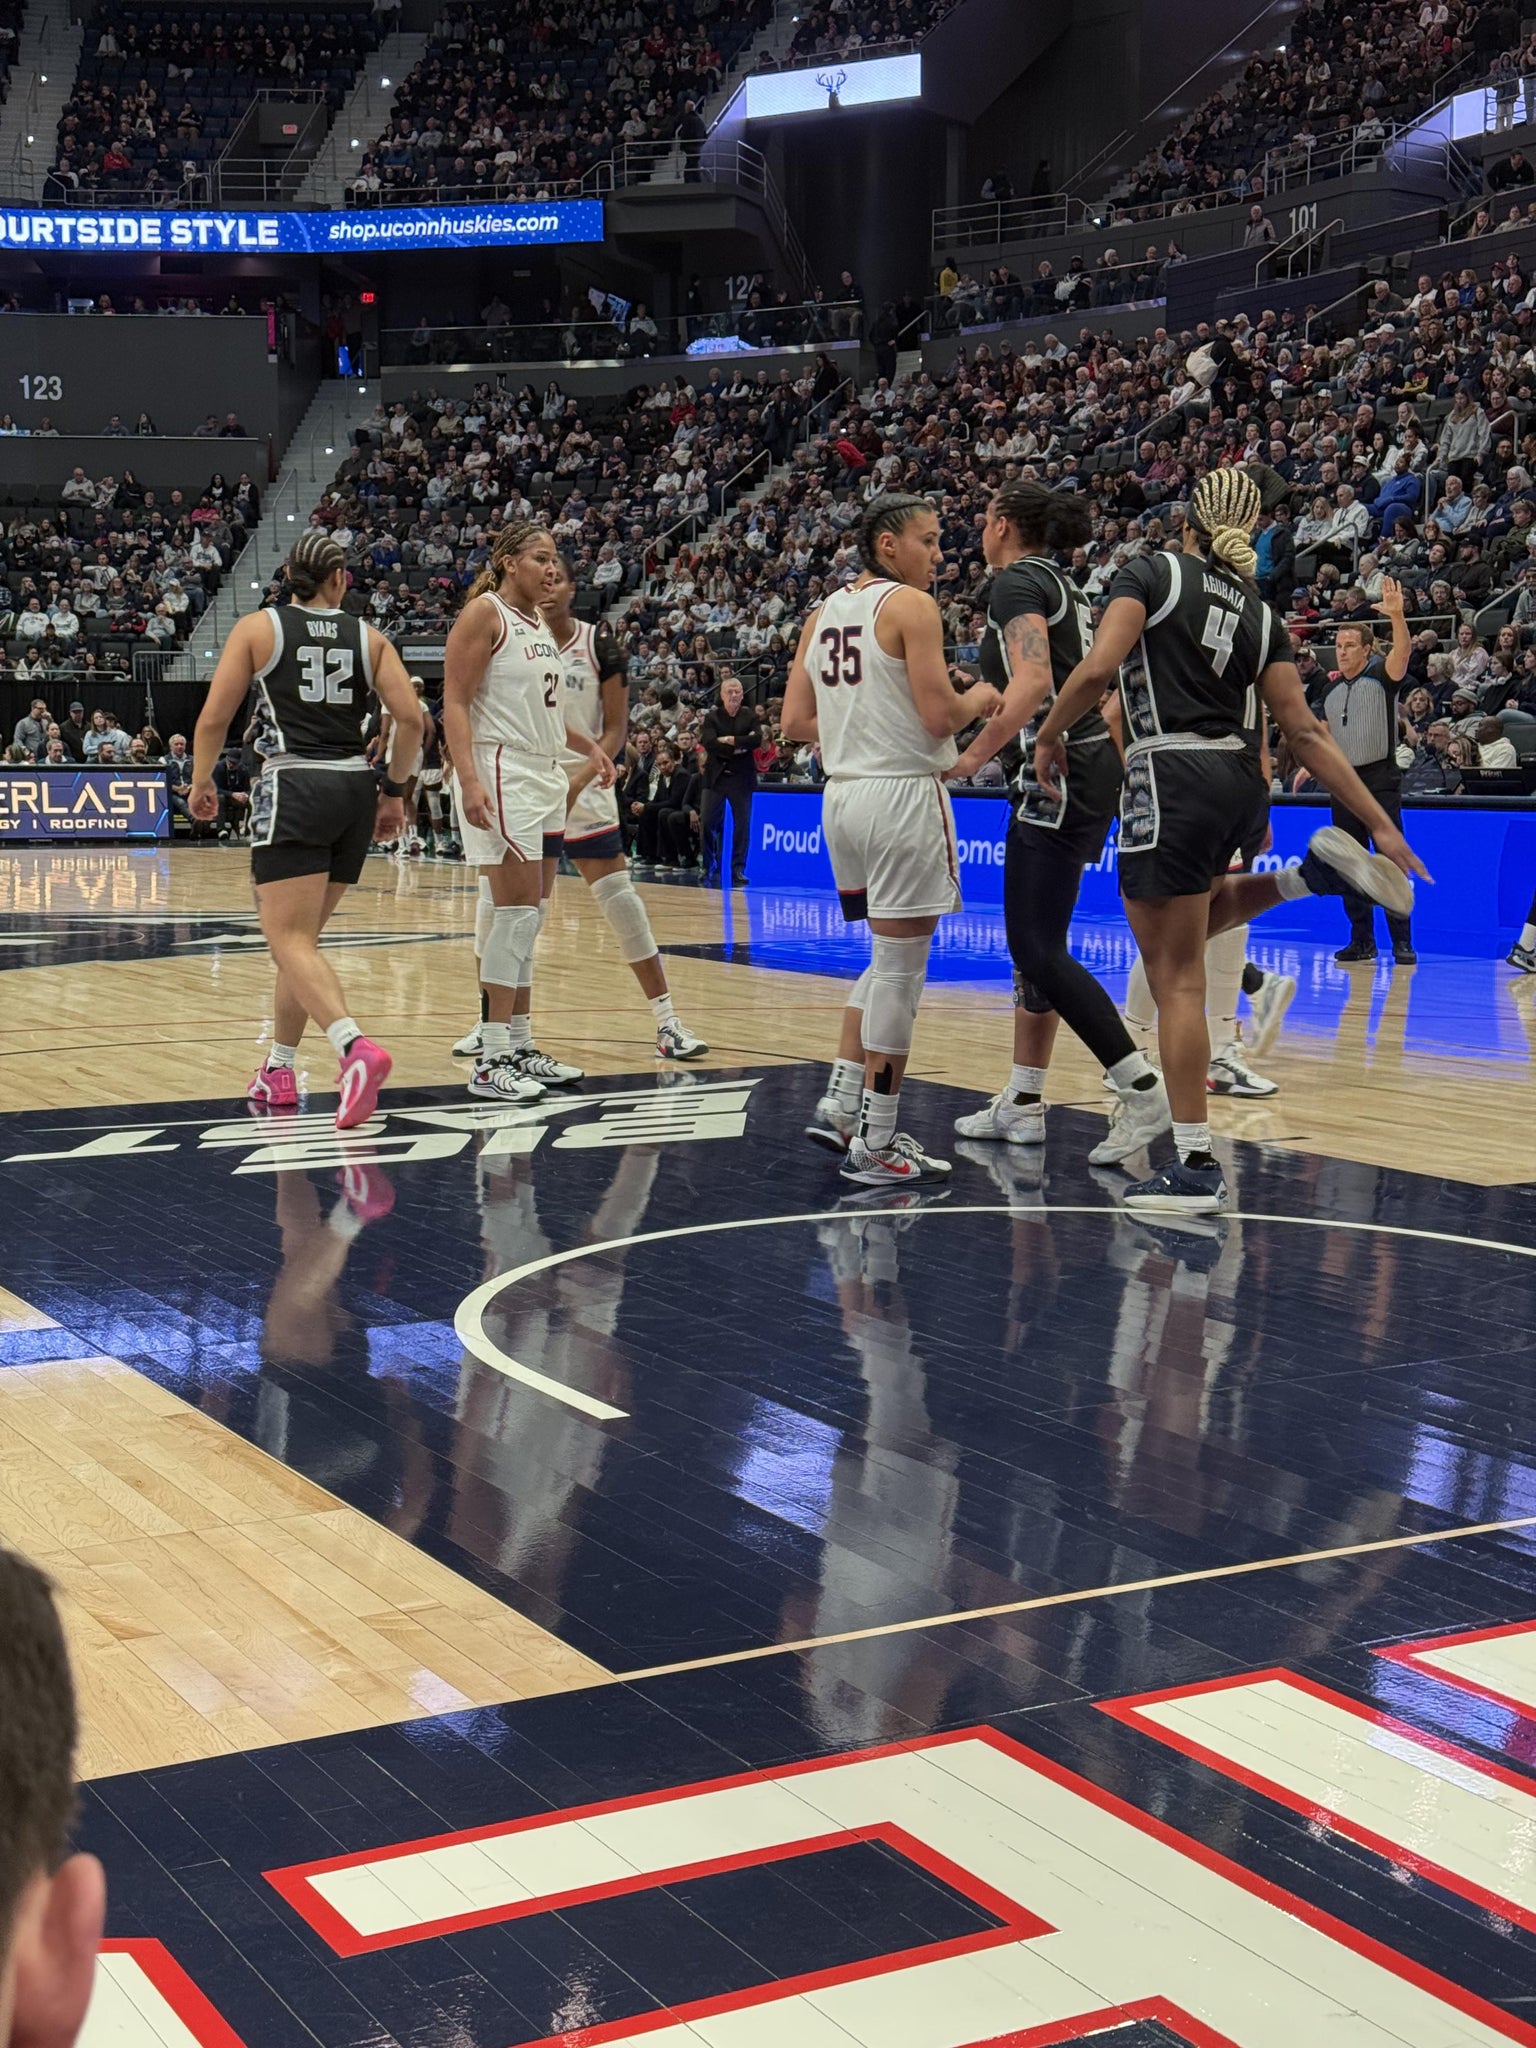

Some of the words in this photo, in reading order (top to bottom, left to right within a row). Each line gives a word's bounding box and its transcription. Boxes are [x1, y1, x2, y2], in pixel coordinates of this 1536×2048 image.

[0, 216, 161, 244] URTSIDE
[170, 218, 279, 246] STYLE
[328, 213, 559, 242] shop.uconnhuskies.com
[1288, 202, 1317, 235] 101
[18, 374, 63, 401] 123
[1202, 572, 1246, 613] AGUBATA
[306, 620, 338, 639] BYARS
[1201, 604, 1240, 679] 4
[296, 645, 354, 704] 32
[819, 624, 863, 688] 35
[50, 819, 128, 829] ROOFING
[762, 823, 822, 854] Proud
[957, 838, 1006, 866] ome
[230, 1111, 749, 1175] BIG
